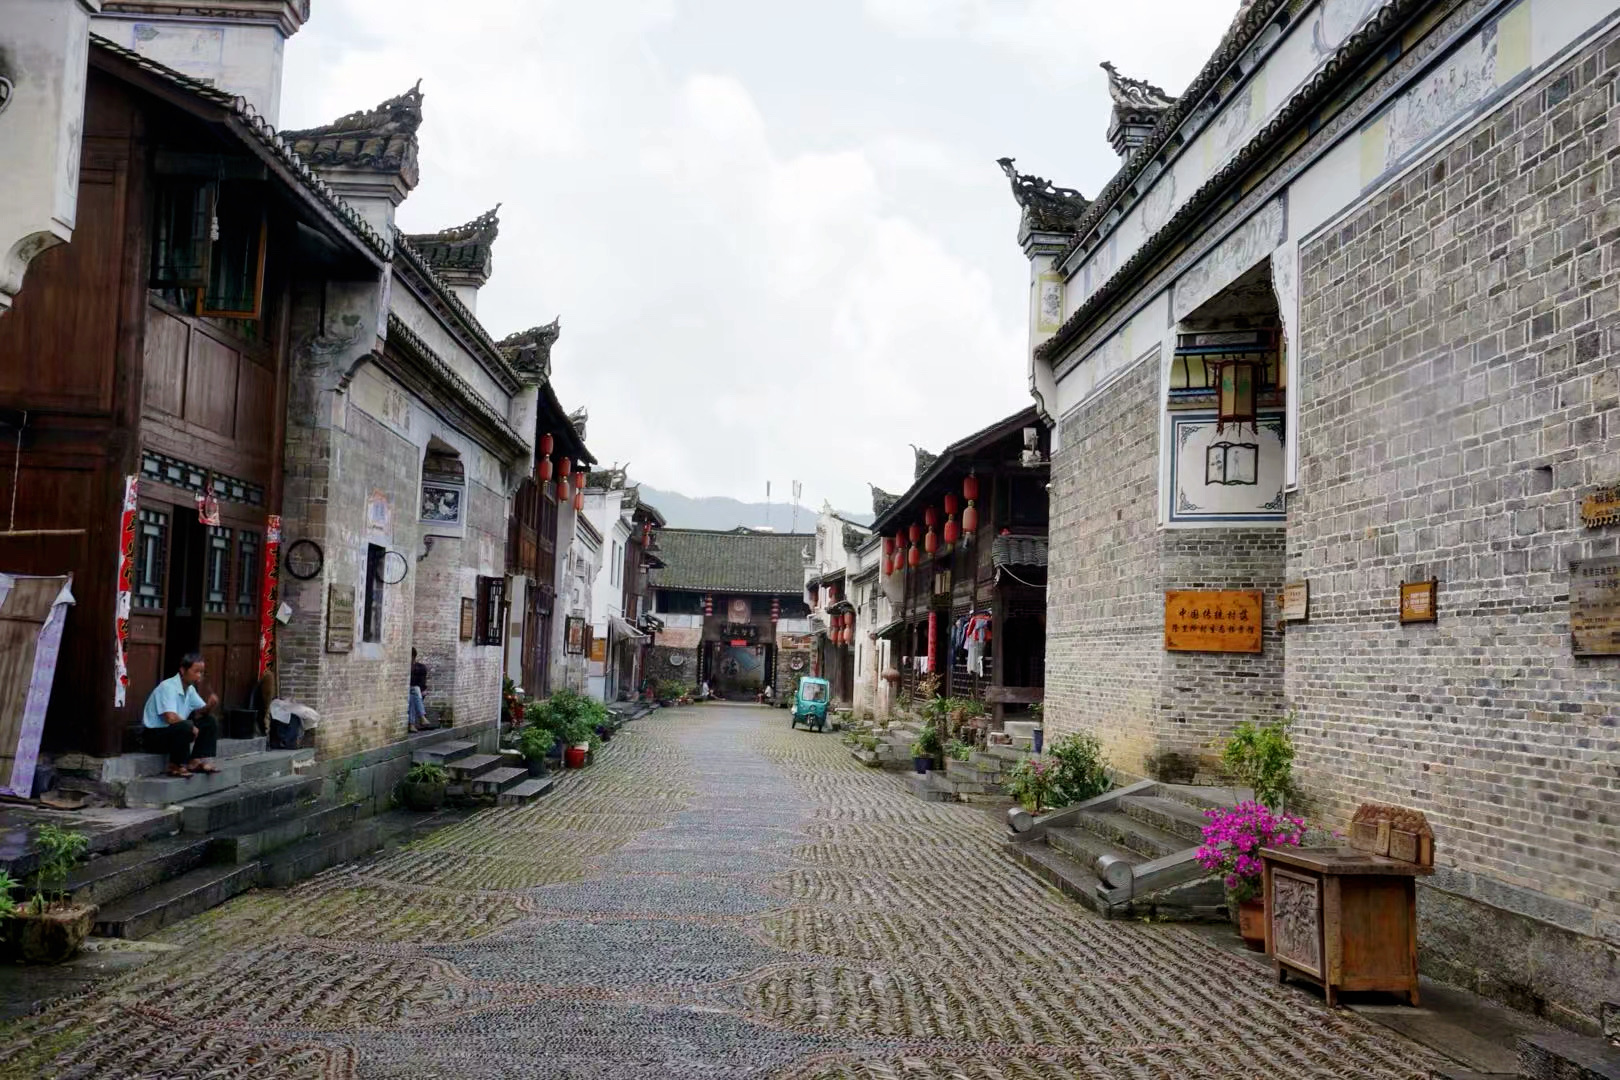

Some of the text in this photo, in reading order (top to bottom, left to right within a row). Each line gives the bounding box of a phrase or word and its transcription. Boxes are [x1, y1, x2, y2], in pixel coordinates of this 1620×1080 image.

[1178, 607, 1250, 621] 中国传统村落
